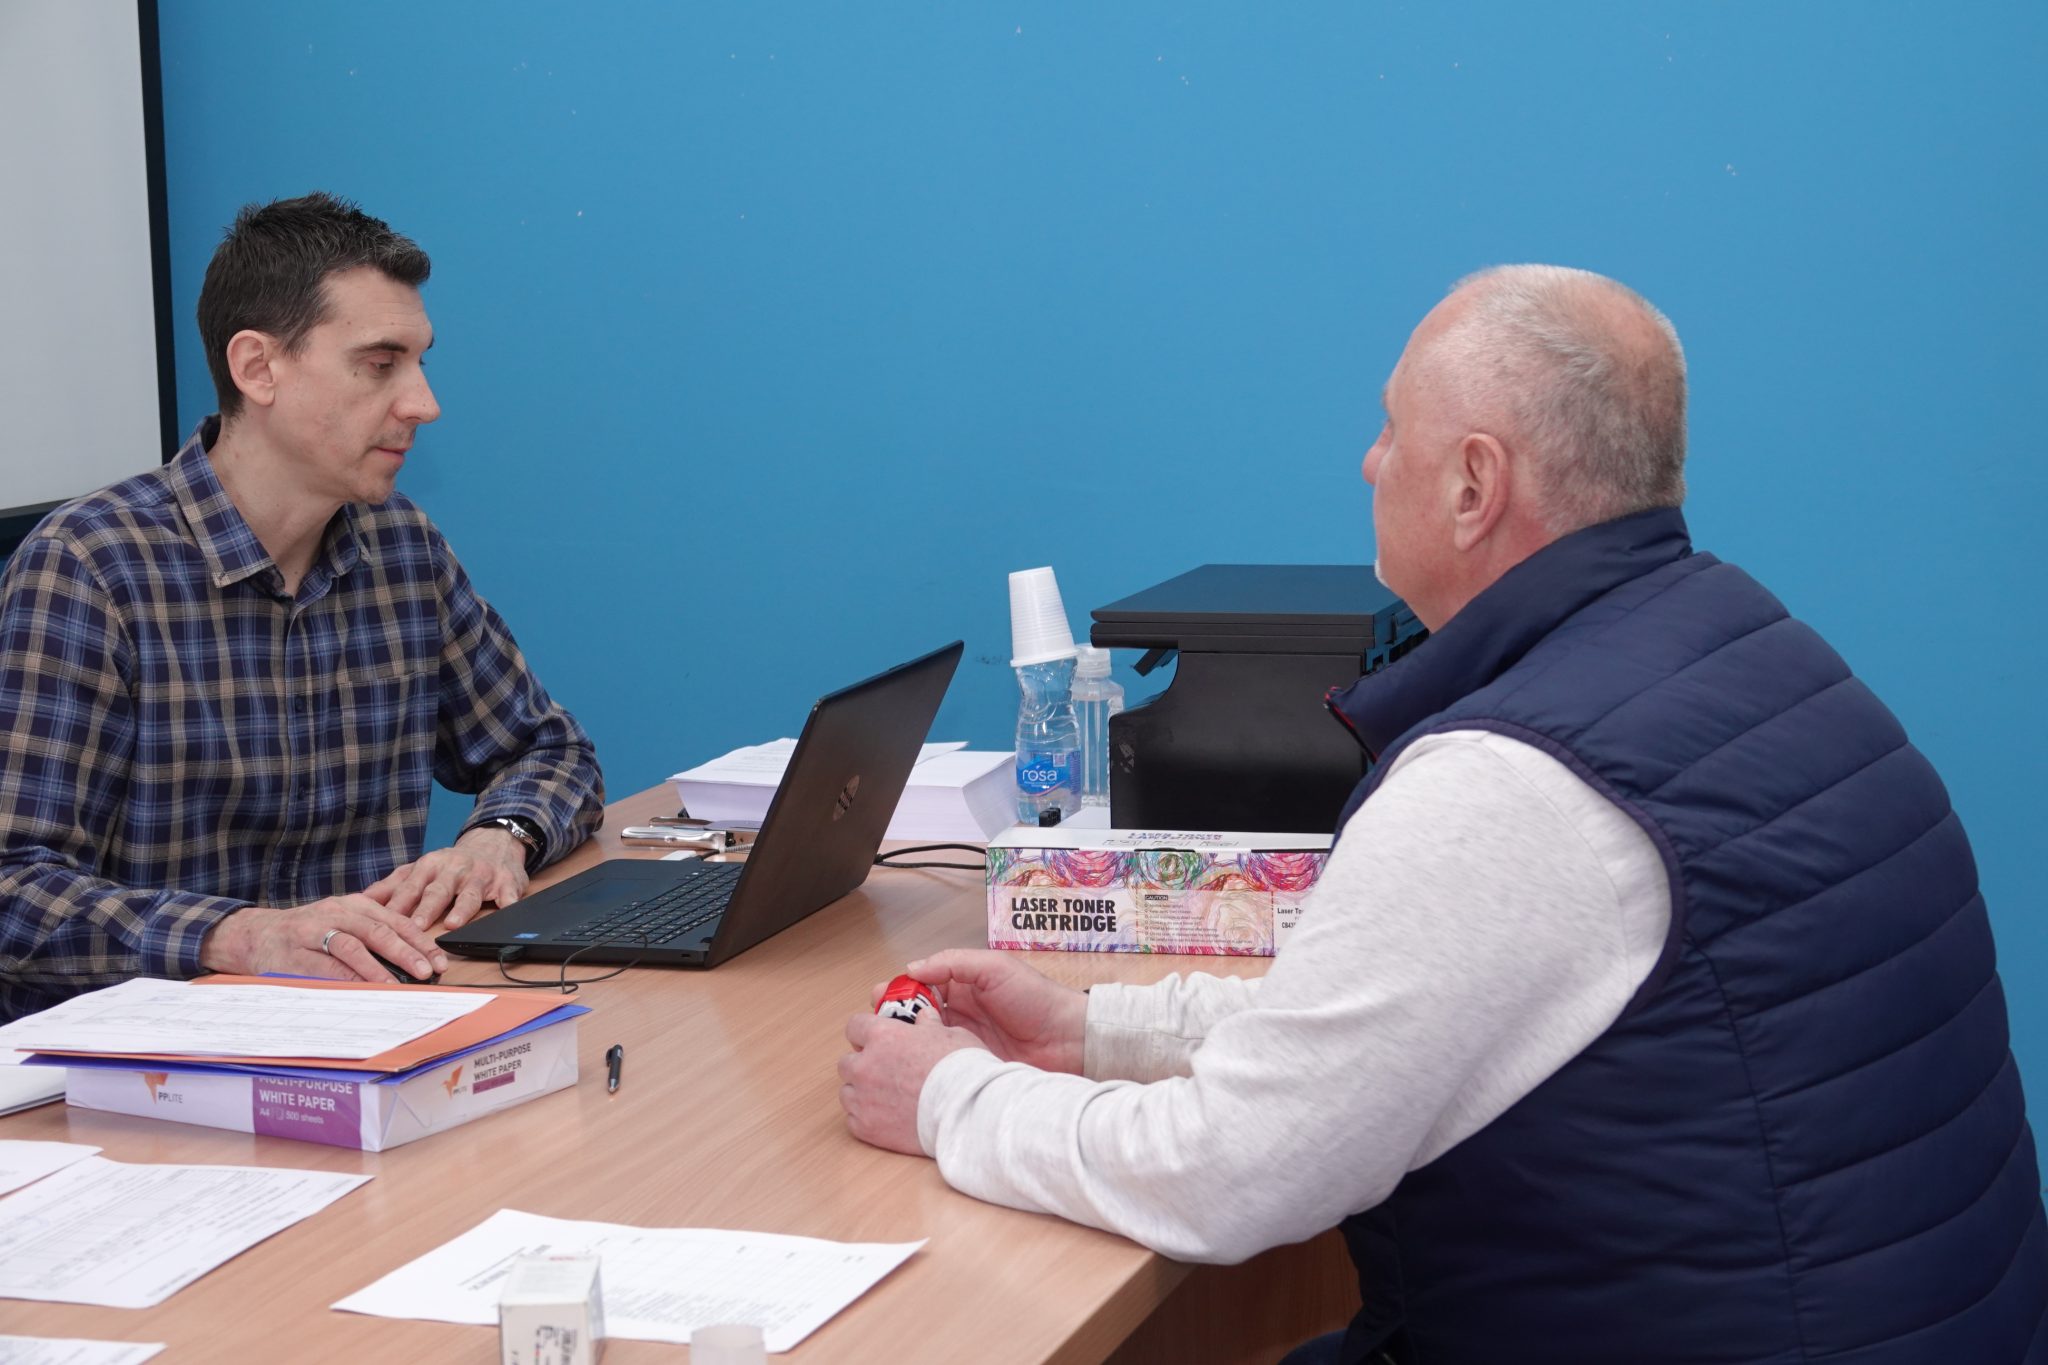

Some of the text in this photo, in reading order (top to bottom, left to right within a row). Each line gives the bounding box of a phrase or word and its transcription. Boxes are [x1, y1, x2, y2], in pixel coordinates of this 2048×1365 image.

[1022, 769, 1057, 782] rosa
[1011, 898, 1116, 914] LASER TONER
[1011, 913, 1117, 932] CARTRIDGE
[474, 1042, 532, 1069] MULTI-PURPOSE
[474, 1059, 522, 1081] WHITE PAPER
[158, 1091, 184, 1104] PPLITE
[259, 1089, 336, 1112] WHITE PAPER
[260, 1107, 325, 1125] A4 500 sheets
